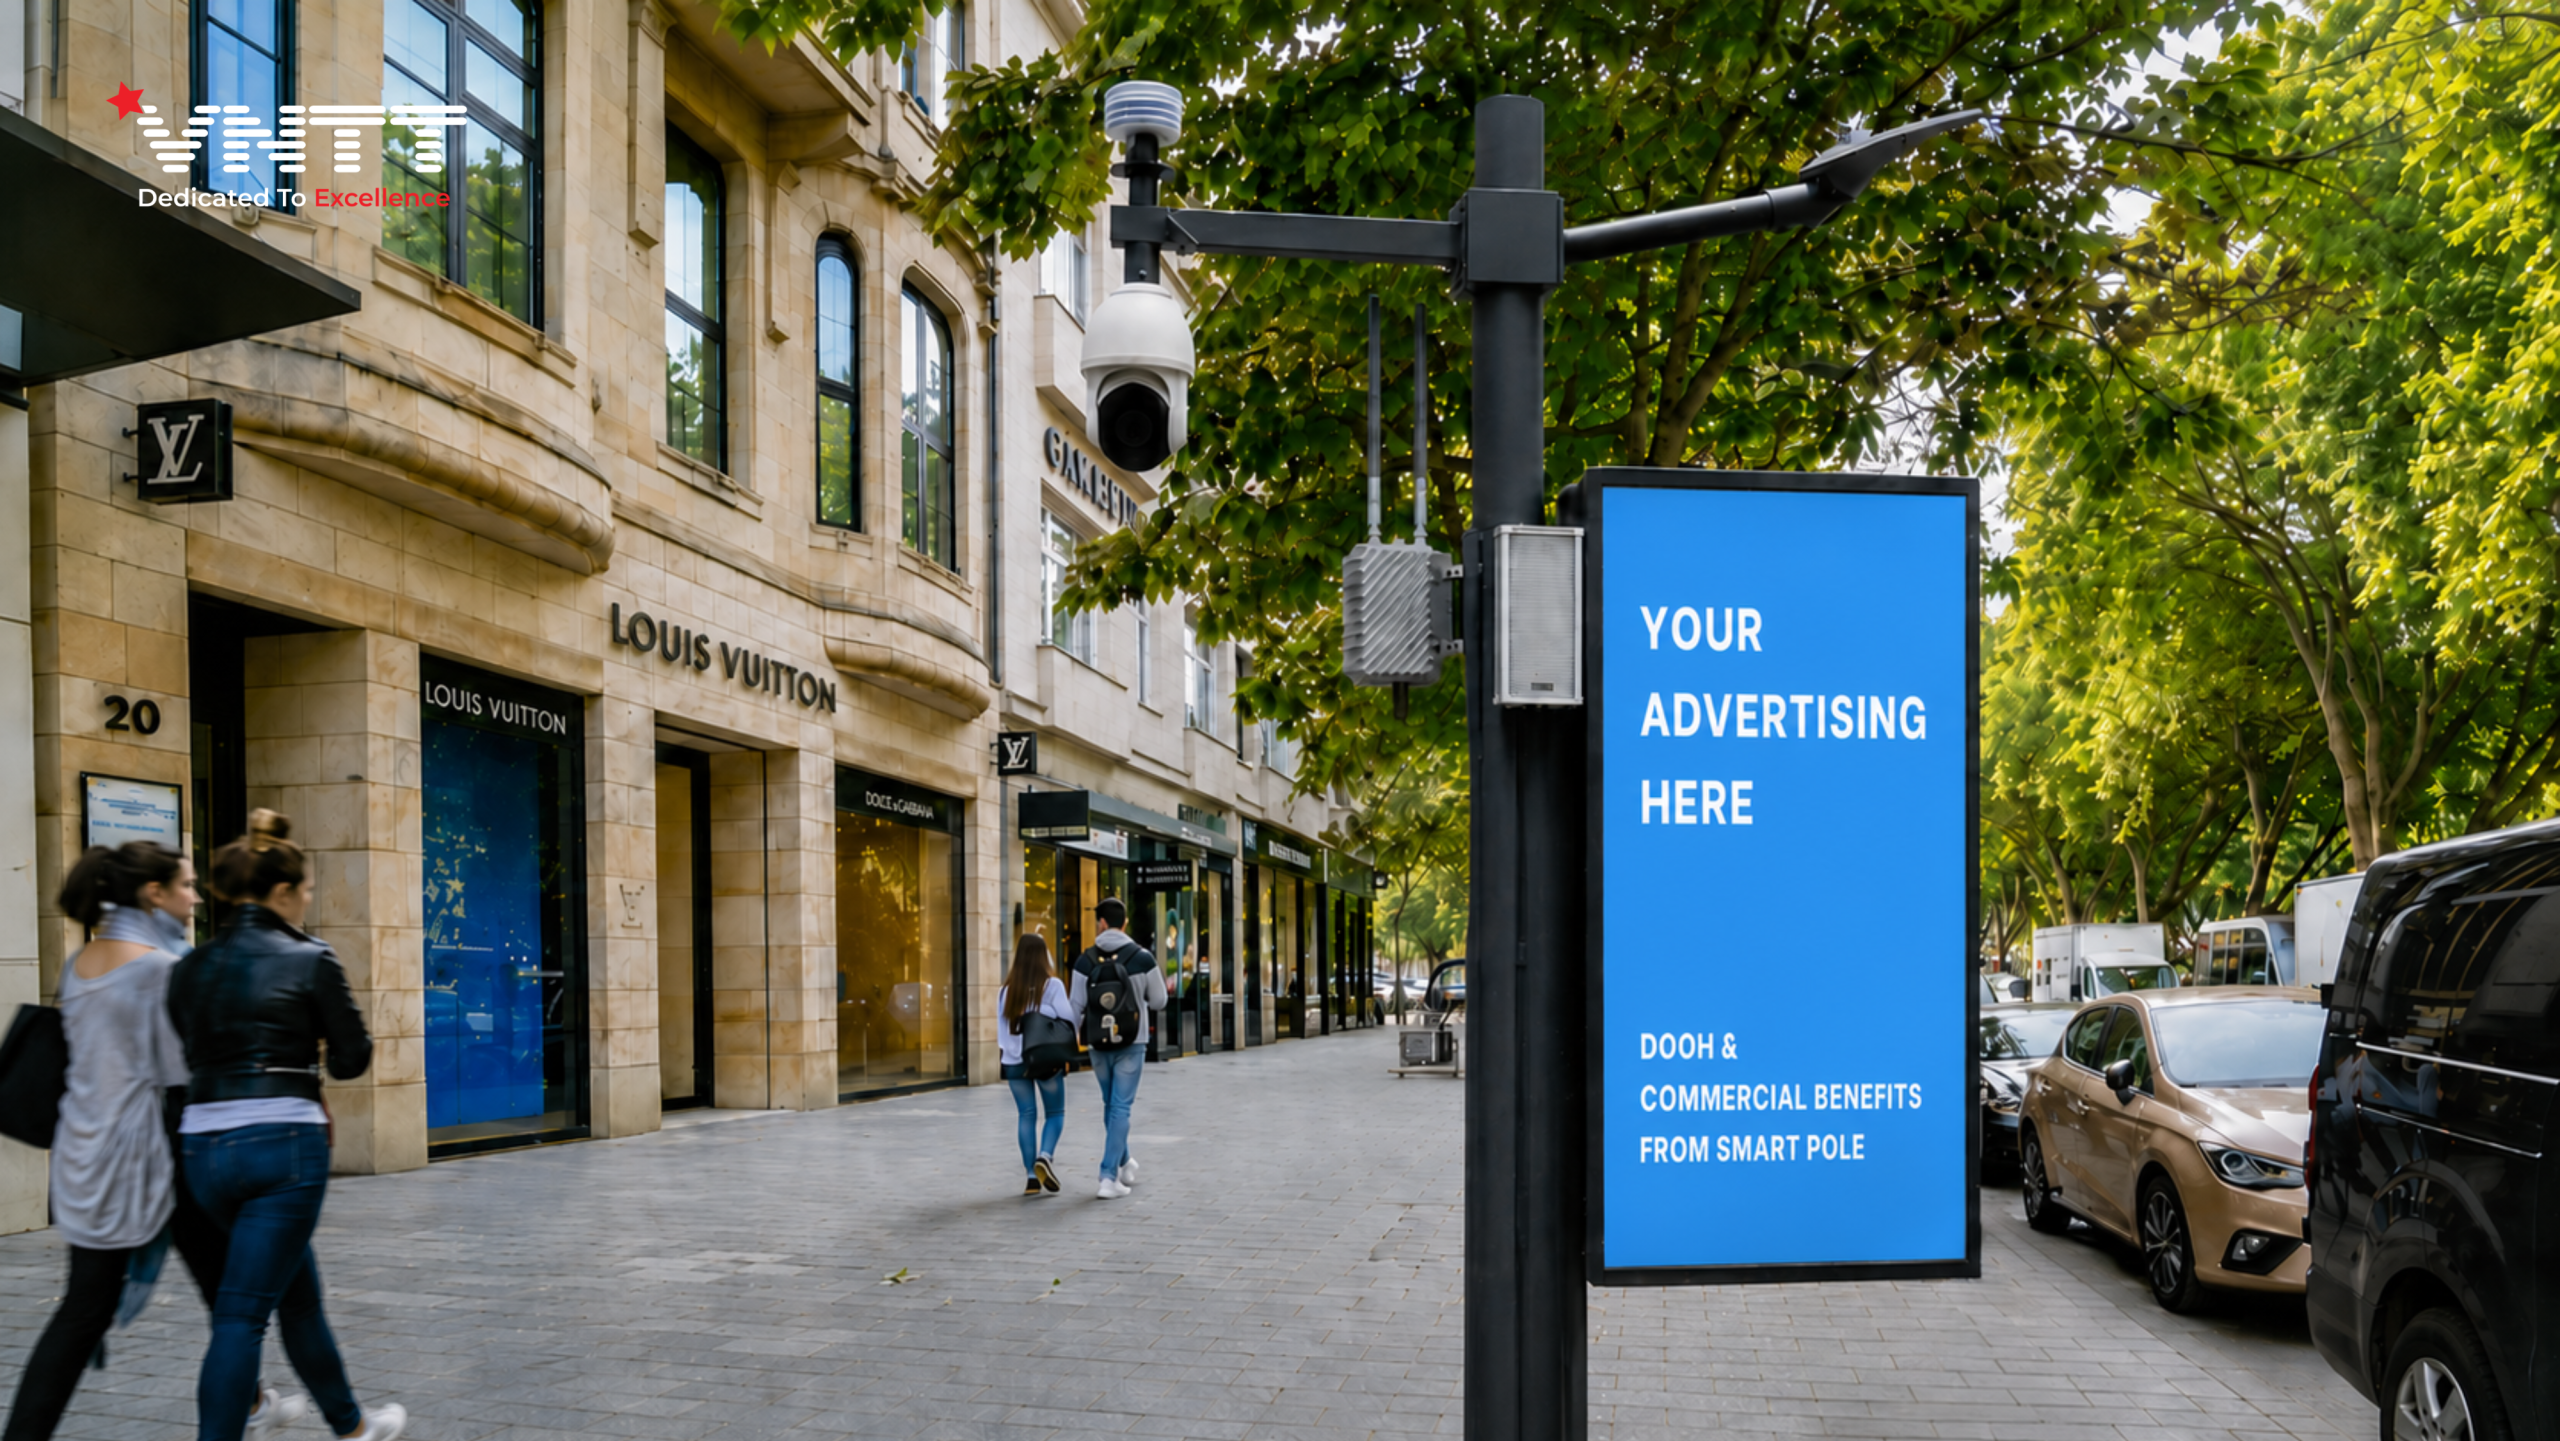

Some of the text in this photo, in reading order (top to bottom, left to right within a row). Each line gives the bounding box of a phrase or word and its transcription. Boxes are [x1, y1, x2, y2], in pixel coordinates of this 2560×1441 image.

[1640, 606, 1762, 652] YOUR
[611, 602, 837, 714] LOUIS VUITTON
[103, 694, 161, 736] 20
[425, 681, 567, 736] LOUIS VUITTON
[1640, 692, 1926, 740] ADVERTISING
[1641, 779, 1753, 825] HERE
[1640, 1032, 1738, 1060] DOOH &
[1640, 1083, 1922, 1112] COMMERCIAL BENEFITS
[1640, 1133, 1865, 1163] FROM SMART POLE
